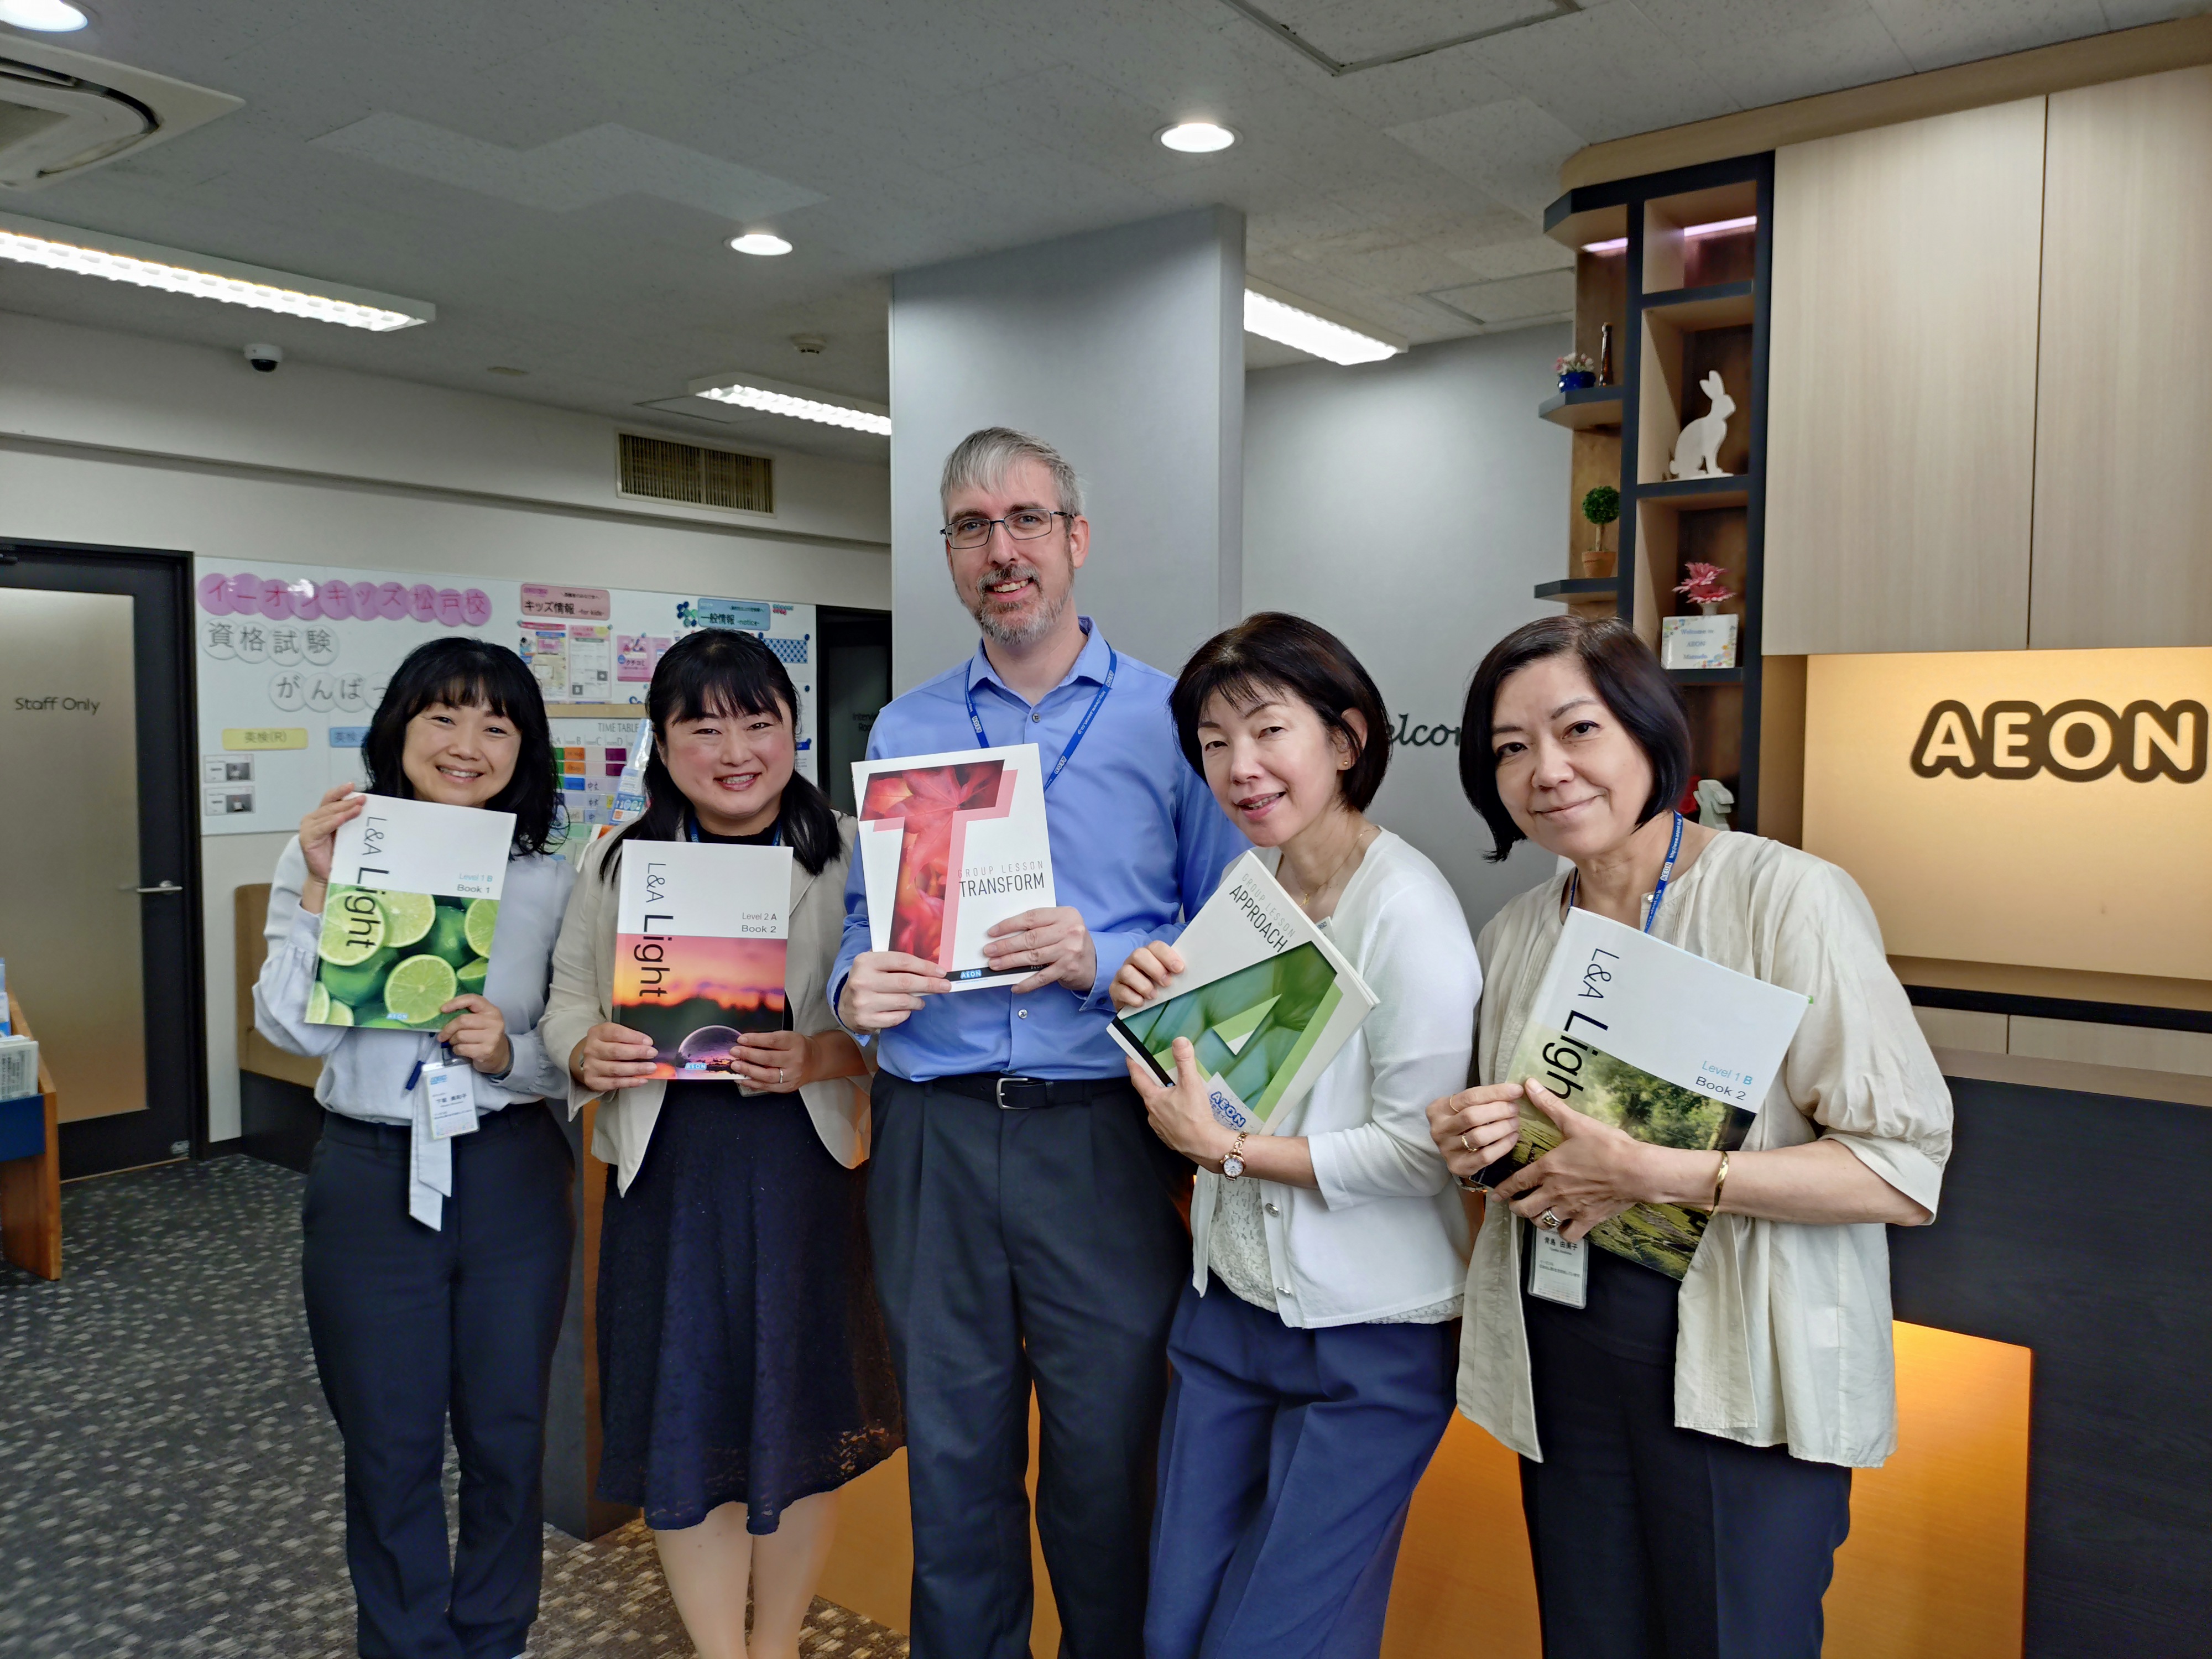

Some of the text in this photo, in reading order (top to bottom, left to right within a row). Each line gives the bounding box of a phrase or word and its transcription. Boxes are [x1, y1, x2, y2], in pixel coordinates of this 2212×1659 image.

[525, 600, 575, 614] キッズ情報
[208, 622, 333, 654] 資格試験
[15, 697, 100, 716] Staff Only
[1910, 699, 2208, 784] AEON
[1055, 755, 1067, 775] AEON
[958, 860, 1043, 879] GROUP LESSON
[1660, 862, 1673, 881] AEON
[345, 816, 390, 949] L&A Light
[457, 884, 482, 894] Book
[958, 872, 1045, 898] TRANSFORM
[742, 912, 762, 920] Level
[1242, 873, 1296, 937] GROUP LESSON
[634, 863, 674, 997] L&A Light
[742, 925, 767, 933] Book
[1229, 885, 1288, 953] APPROACH
[961, 969, 982, 979] AEON
[1542, 948, 1620, 1099] L&A Ligh
[1702, 1061, 1753, 1085] Level 1 B
[1695, 1076, 1746, 1100] Book 2
[1211, 1091, 1246, 1128] AEON
